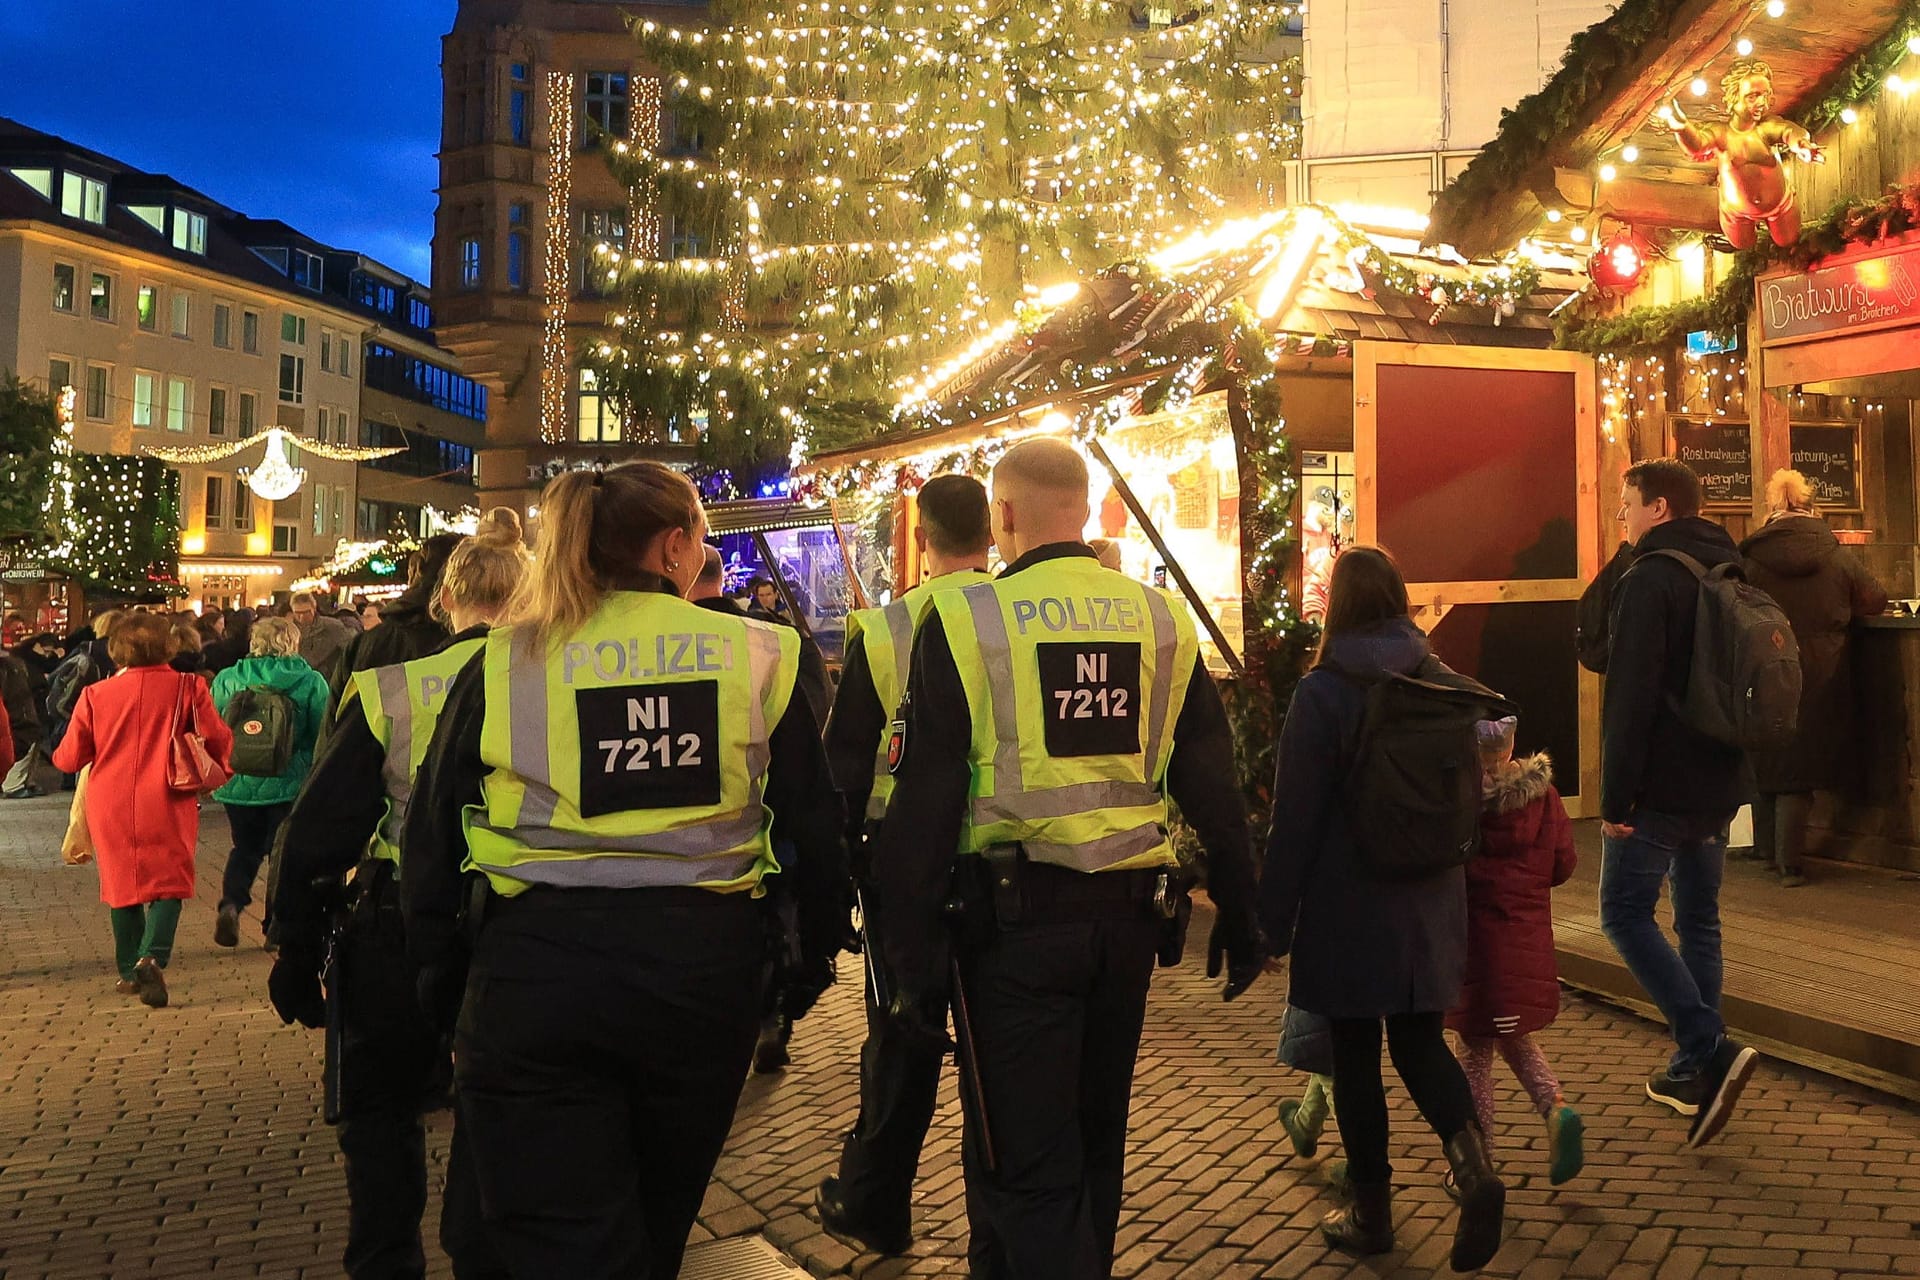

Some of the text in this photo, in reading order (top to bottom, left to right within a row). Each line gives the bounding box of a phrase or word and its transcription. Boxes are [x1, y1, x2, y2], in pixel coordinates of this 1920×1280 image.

[1767, 279, 1876, 330] Bratwurst
[1013, 597, 1145, 635] POLIZEI
[562, 633, 734, 684] POLIZEI
[1076, 653, 1108, 683] NI
[627, 695, 670, 732] NI
[1054, 688, 1128, 720] 7212
[598, 733, 702, 773] 7212
